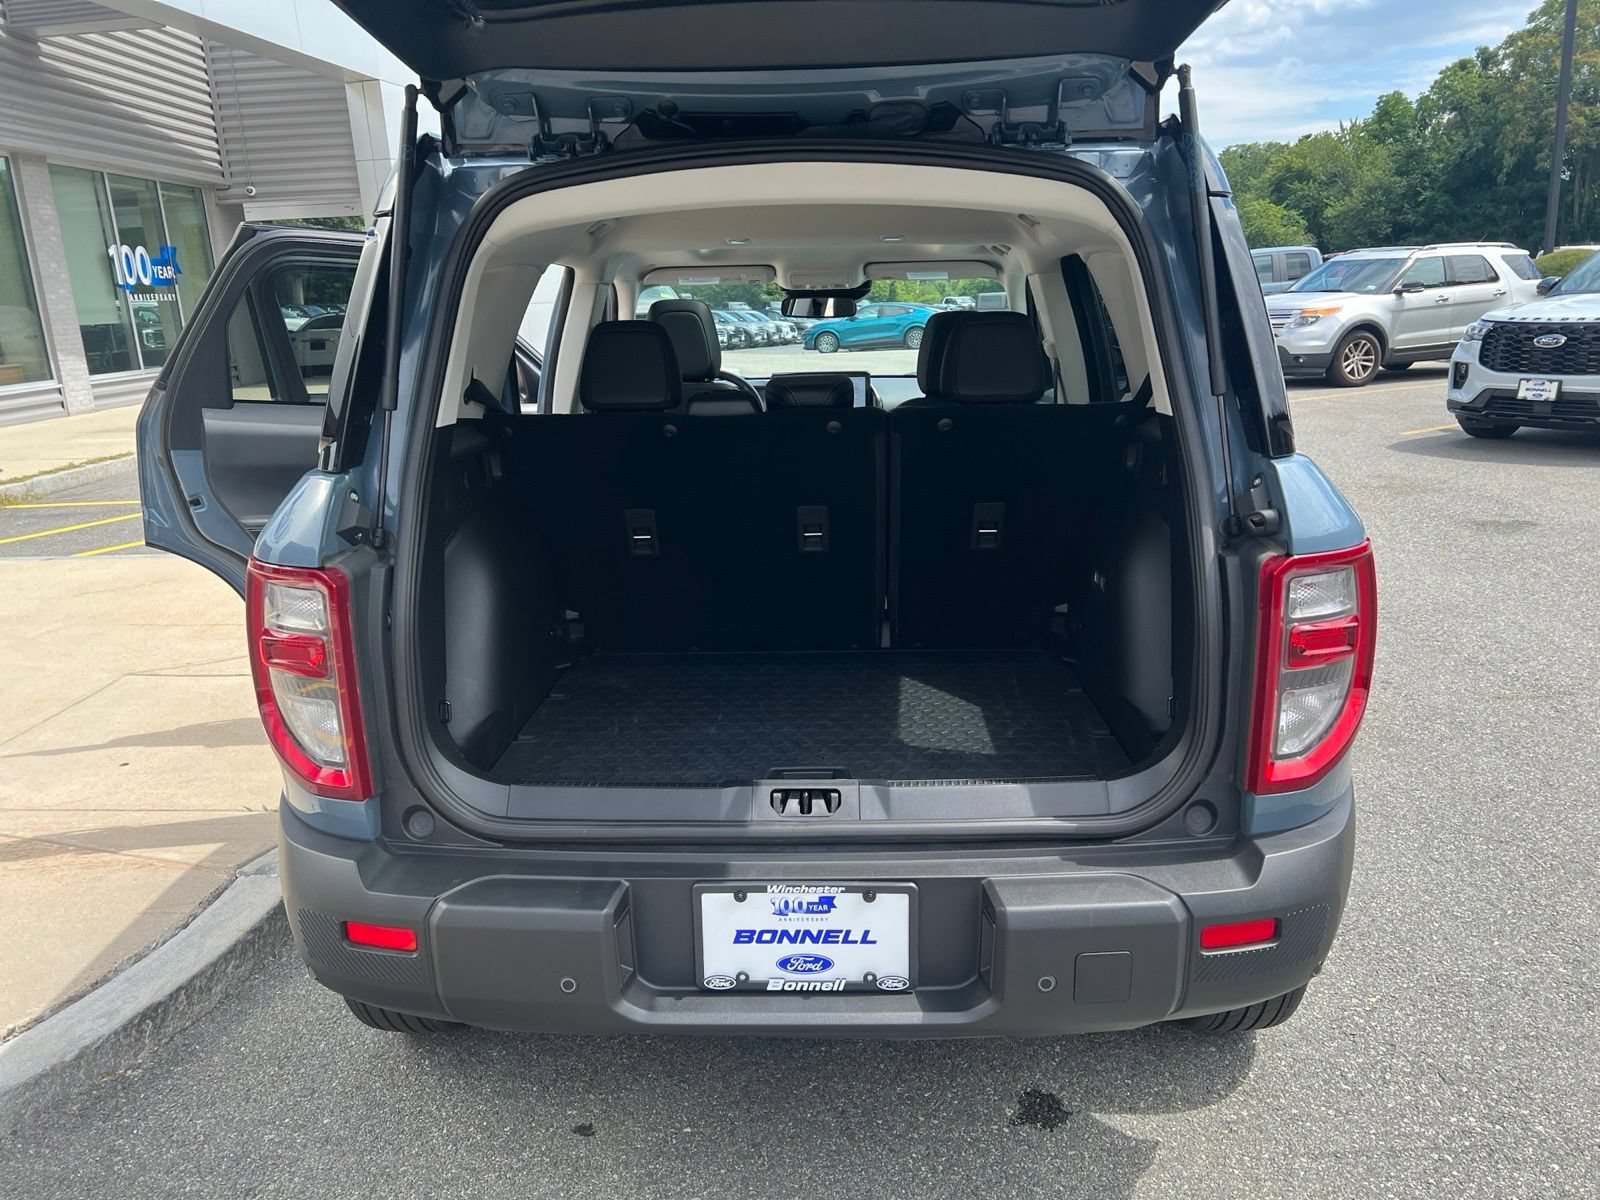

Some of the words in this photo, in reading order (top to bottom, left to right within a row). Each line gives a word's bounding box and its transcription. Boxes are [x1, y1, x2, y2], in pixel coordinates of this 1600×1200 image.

[108, 244, 152, 286] 100
[129, 293, 176, 302] ANNIVERSARY
[766, 884, 846, 894] Winchester
[771, 896, 808, 914] 100
[808, 904, 829, 912] YEAR
[732, 928, 878, 945] BONNELL
[786, 956, 824, 971] Ford
[709, 977, 732, 988] Ford
[766, 977, 847, 991] Bonnell
[881, 977, 904, 989] Ford
